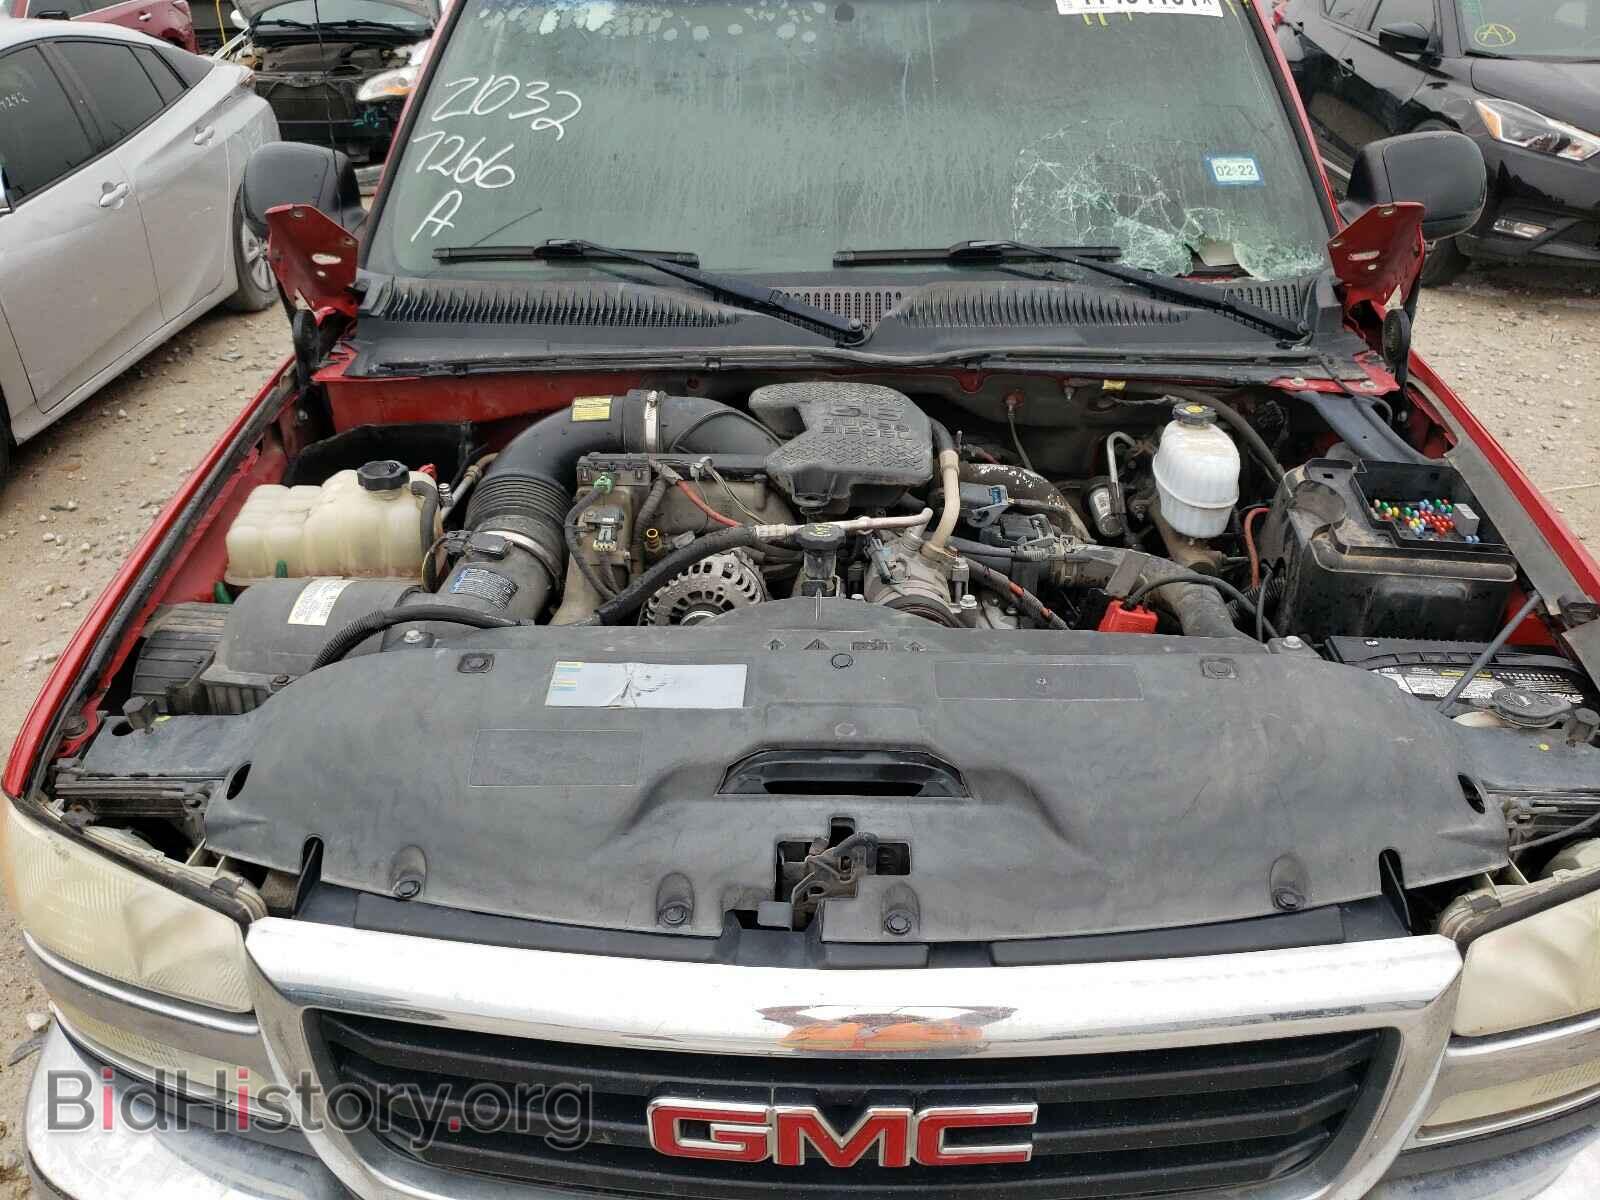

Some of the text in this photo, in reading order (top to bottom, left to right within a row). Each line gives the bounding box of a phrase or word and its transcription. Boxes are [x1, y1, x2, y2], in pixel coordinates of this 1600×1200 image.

[413, 131, 515, 189] 7266
[410, 190, 463, 242] A
[646, 1097, 1038, 1168] GMC
